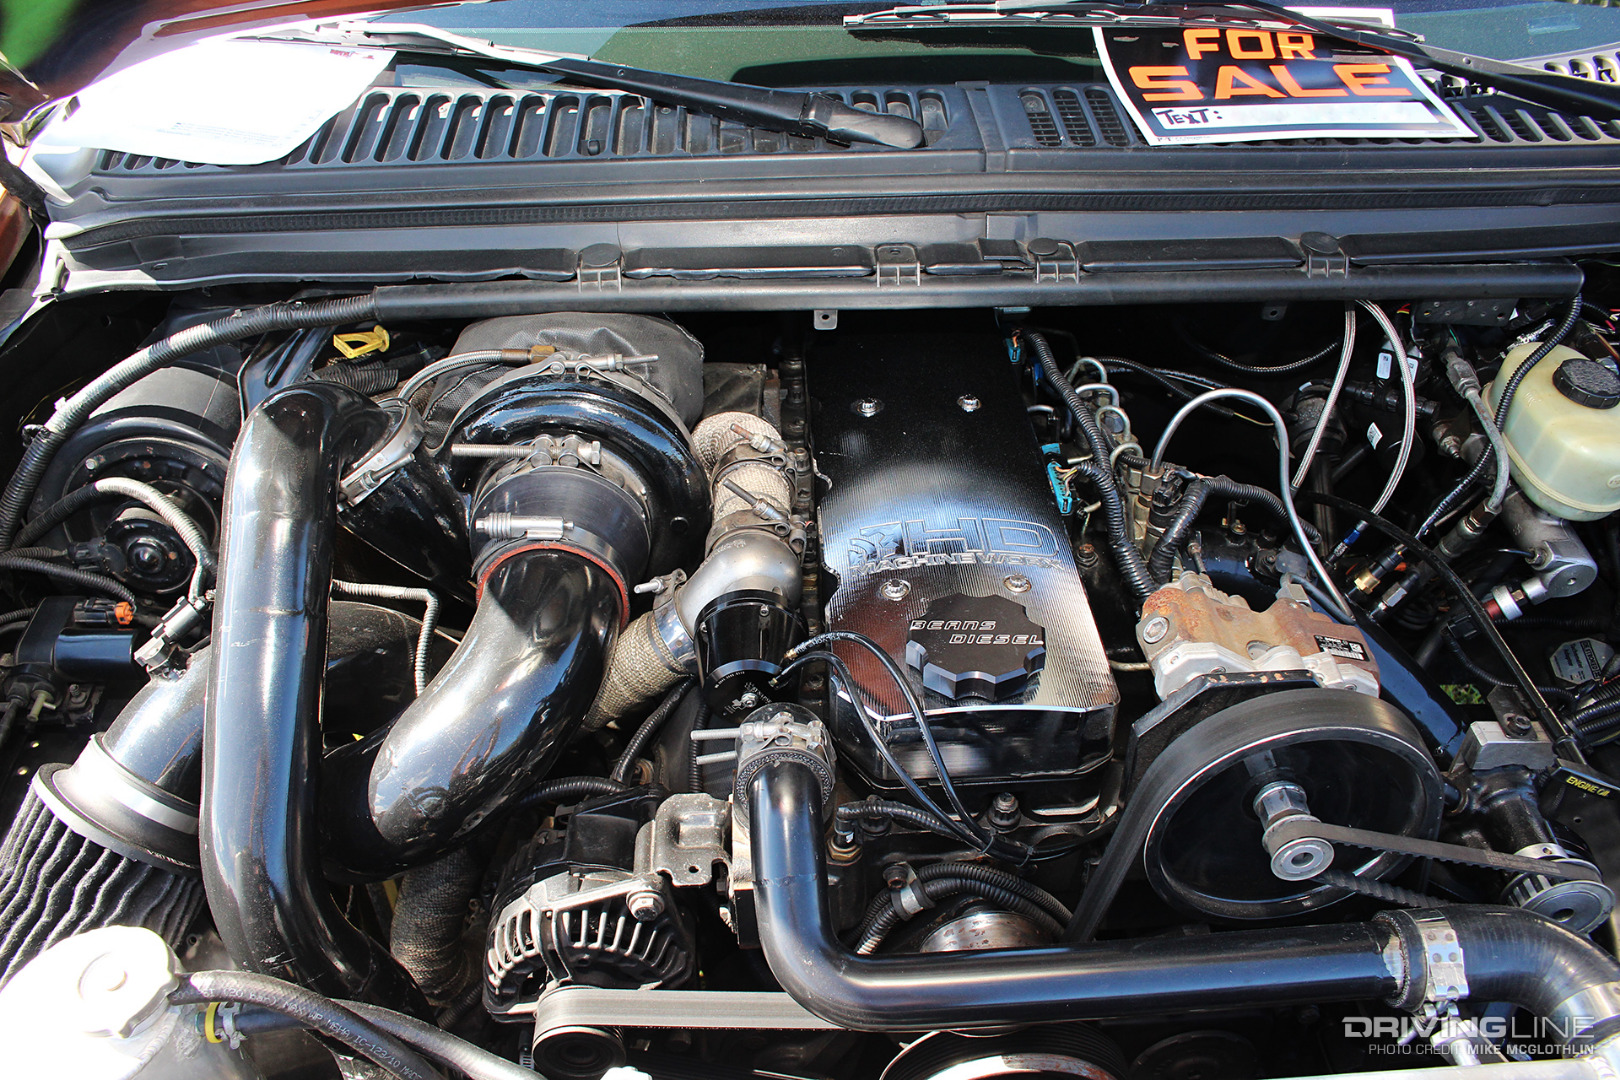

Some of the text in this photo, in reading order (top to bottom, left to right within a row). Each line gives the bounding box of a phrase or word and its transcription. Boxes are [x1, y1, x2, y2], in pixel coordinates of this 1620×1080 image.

[1183, 28, 1317, 60] FOR
[1128, 64, 1412, 101] SALE
[909, 619, 996, 631] BEANS
[948, 633, 1044, 645] DIESEL
[1566, 776, 1599, 793] ENGINE
[353, 1035, 401, 1068] IC-123/10
